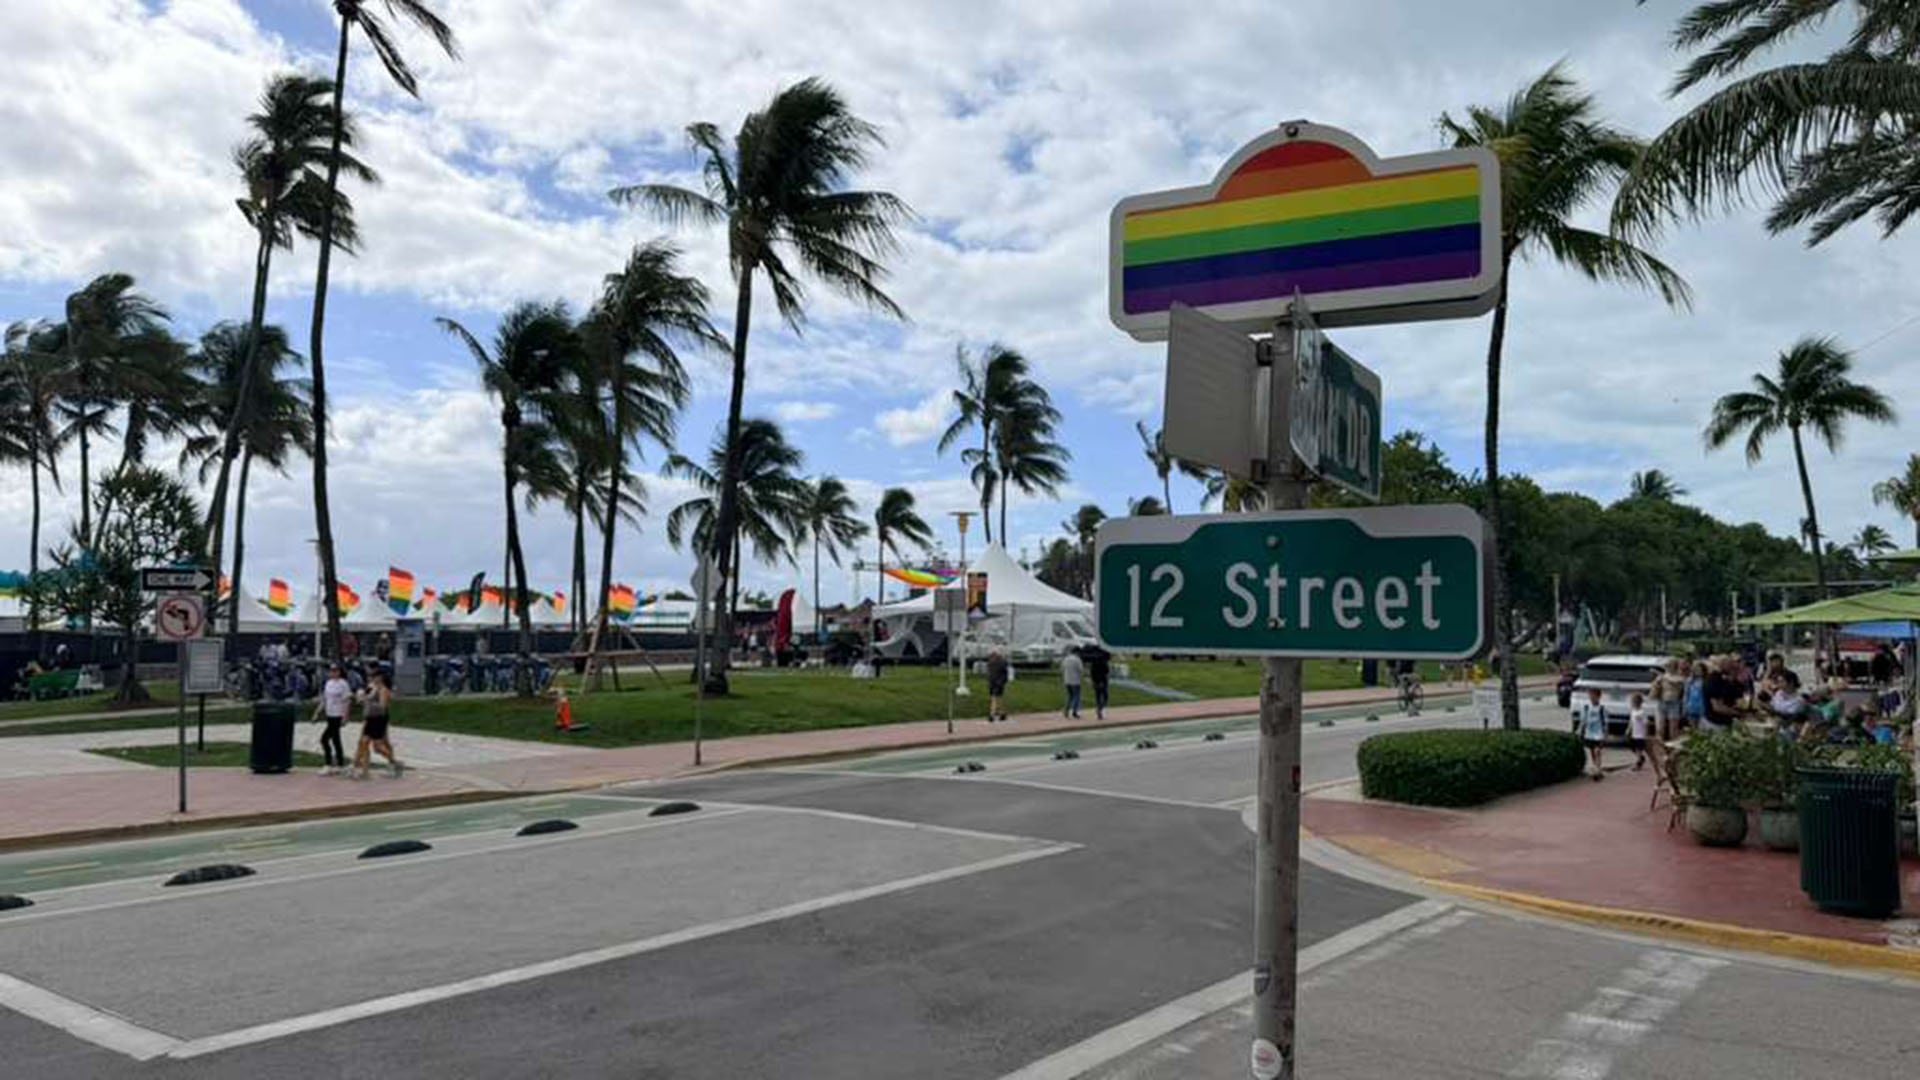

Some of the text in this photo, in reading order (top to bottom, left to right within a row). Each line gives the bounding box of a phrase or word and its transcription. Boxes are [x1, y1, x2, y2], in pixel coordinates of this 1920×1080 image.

[1346, 394, 1371, 481] DR
[1126, 560, 1442, 630] 12 Street
